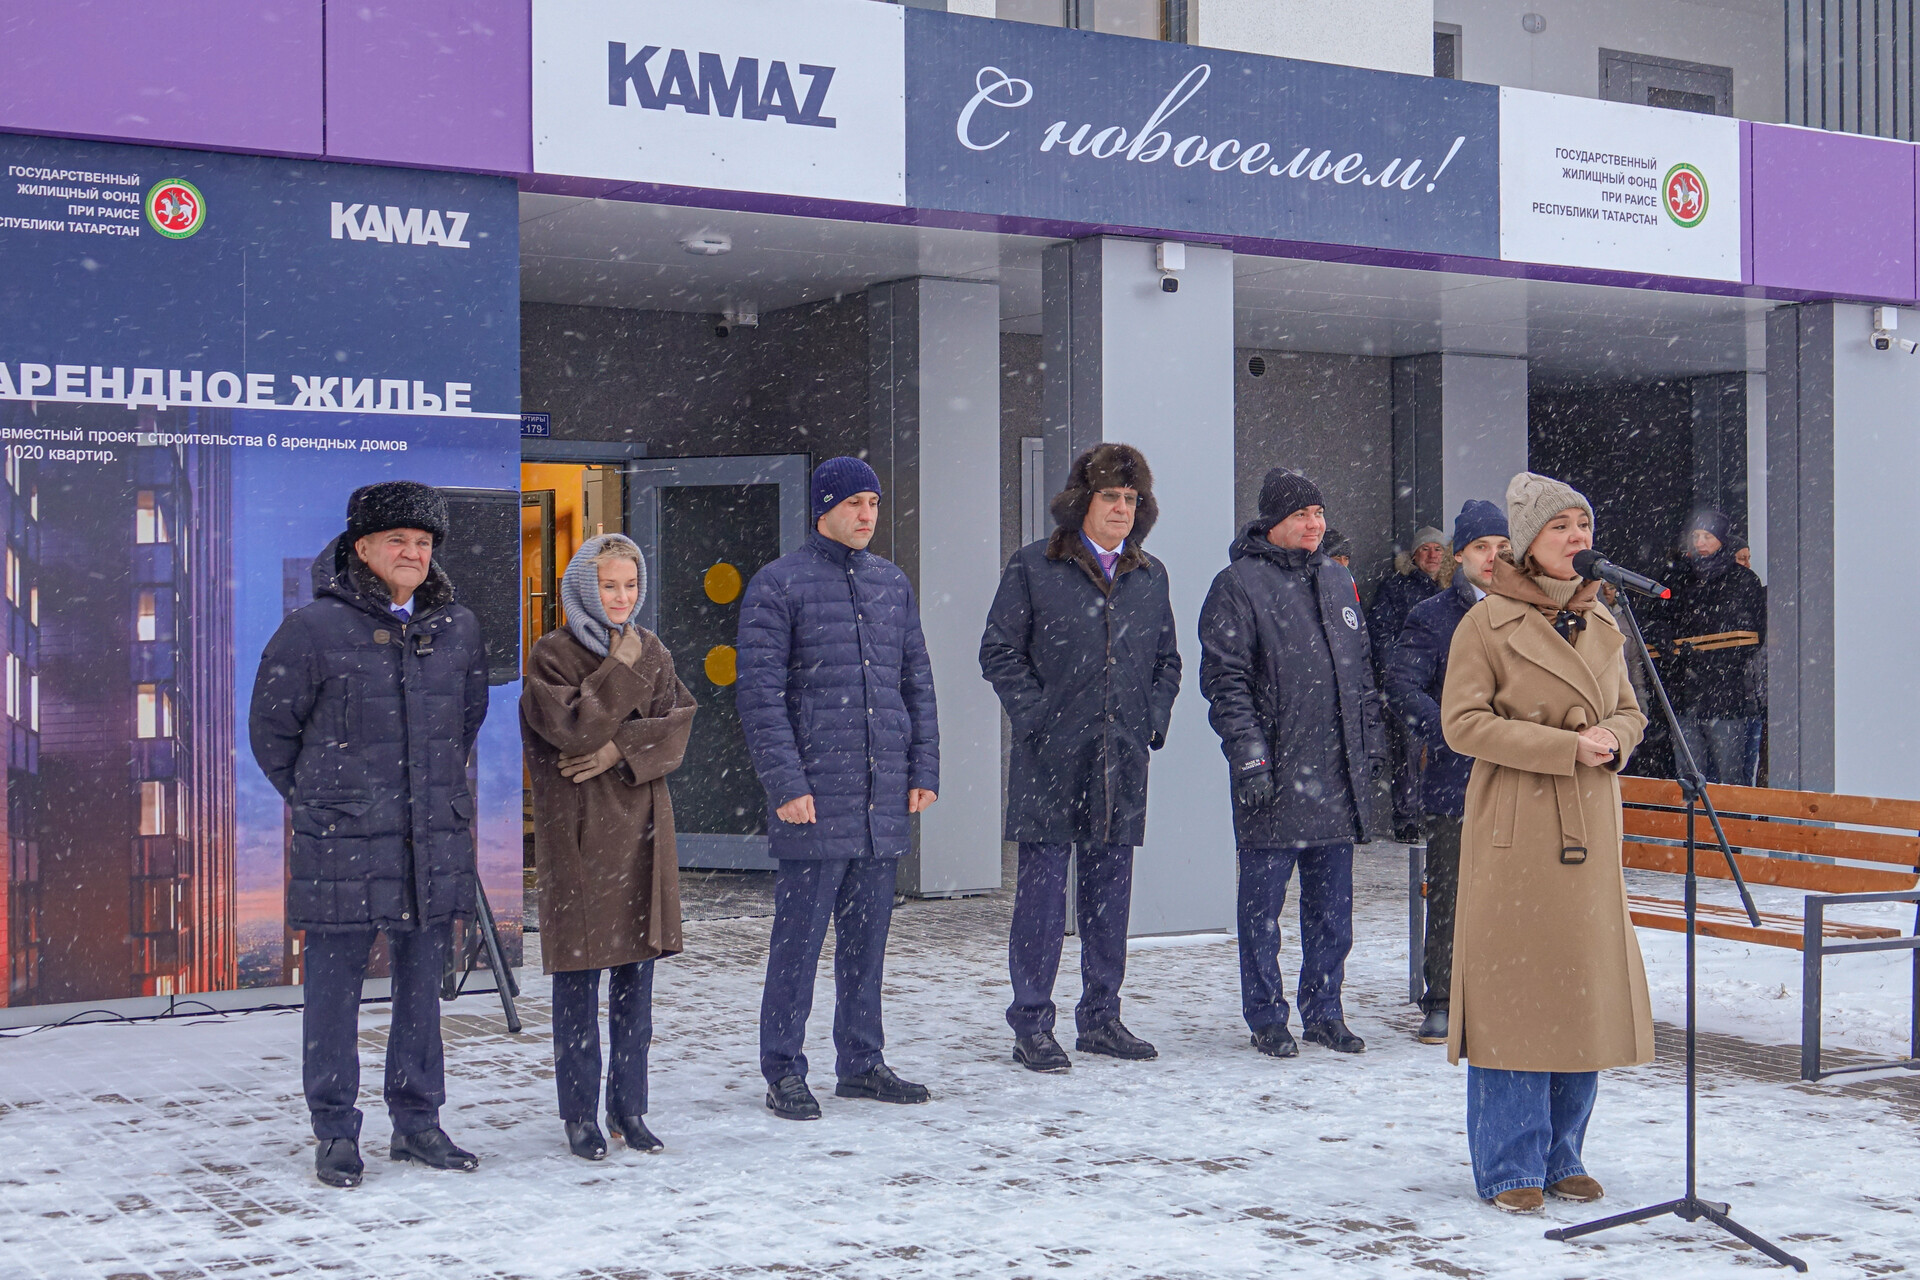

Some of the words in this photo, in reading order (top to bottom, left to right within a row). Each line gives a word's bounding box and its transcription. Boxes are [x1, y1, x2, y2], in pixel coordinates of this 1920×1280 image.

[608, 40, 837, 129] KAMAZ
[956, 66, 1034, 152] С
[1039, 63, 1466, 193] новосельем!
[1555, 147, 1657, 171] ГОСУДАРСТВЕННЫЙ
[8, 165, 140, 186] ГОСУДАРСТВЕННЫЙ
[1562, 167, 1625, 186] ЖИЛИЩНЫЙ
[1627, 175, 1657, 191] ФОНД
[17, 183, 99, 200] ЖИЛИЩНЫЙ
[102, 191, 140, 204] ФОНД
[1601, 190, 1622, 204] ПРИ
[1624, 193, 1657, 207] РАИСЕ
[68, 204, 95, 217] ПРИ
[98, 207, 140, 220] РАИСЕ
[1532, 201, 1599, 220] РЕСПУБЛИКИ
[1602, 209, 1658, 226] ТАТАРСТАН
[68, 222, 140, 237] ТАТАРСТАН
[331, 201, 470, 249] KAMAZ
[291, 374, 472, 414] ЖИЛЬЕ
[0, 427, 83, 442] вместный
[88, 430, 142, 444] проект
[148, 432, 262, 447] строительства
[267, 433, 277, 447] 6
[281, 437, 356, 451] арендных
[360, 439, 408, 452] домов
[4, 444, 44, 459] 1020
[49, 449, 118, 464] квартир.
